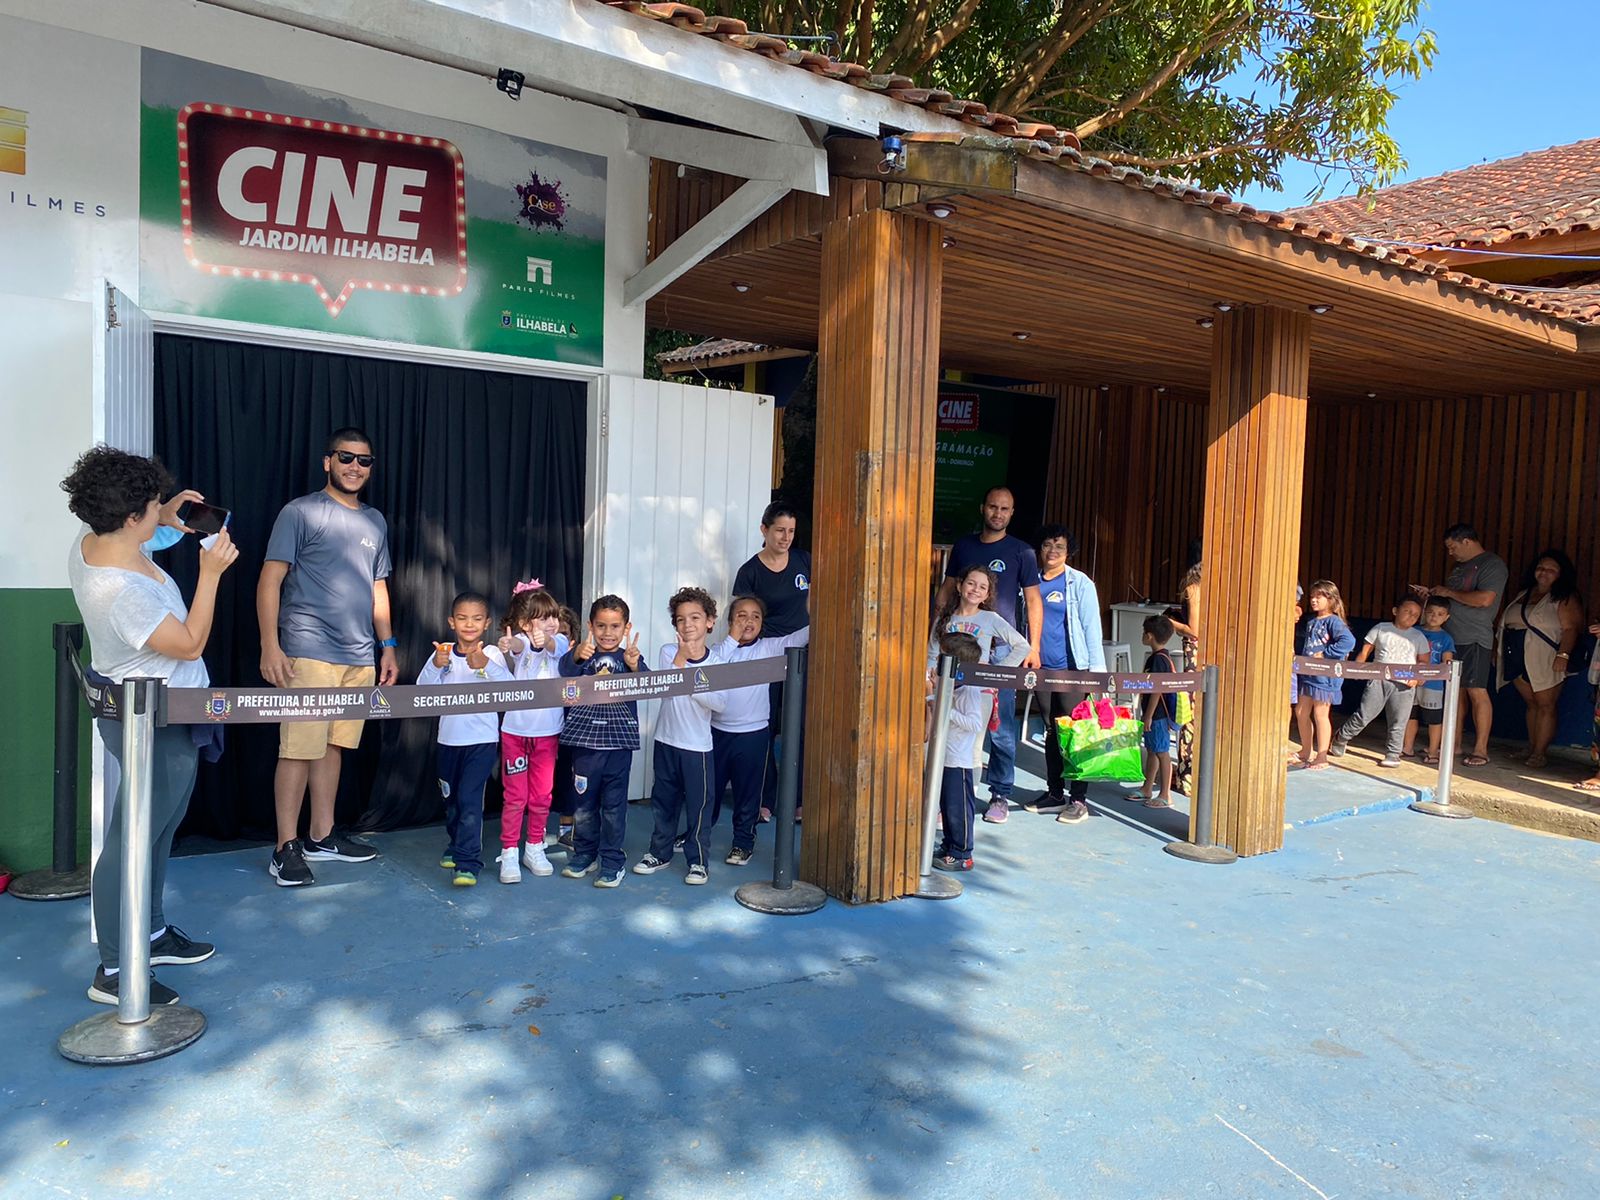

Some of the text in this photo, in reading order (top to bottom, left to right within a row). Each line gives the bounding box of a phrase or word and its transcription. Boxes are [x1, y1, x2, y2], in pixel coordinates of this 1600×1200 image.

[217, 146, 428, 241] CINE
[10, 191, 106, 217] ILMES
[239, 227, 435, 266] JARDIM ILHABELA
[502, 283, 575, 300] PARIS FILMES
[516, 318, 567, 334] ILHABELA
[938, 400, 974, 418] CINE
[936, 442, 994, 457] GRAMAÇÃO
[950, 458, 975, 466] DOMINGO
[593, 673, 684, 691] PREFEITURA DE ILHABELA
[413, 690, 535, 708] SECRETARIA DE TURISMO
[609, 685, 670, 697] www.ilhabela.sp.gov.br
[237, 693, 365, 708] PREFEITURA DE ILHABELA
[258, 706, 345, 717] www.ilhabela.sp.gov.br
